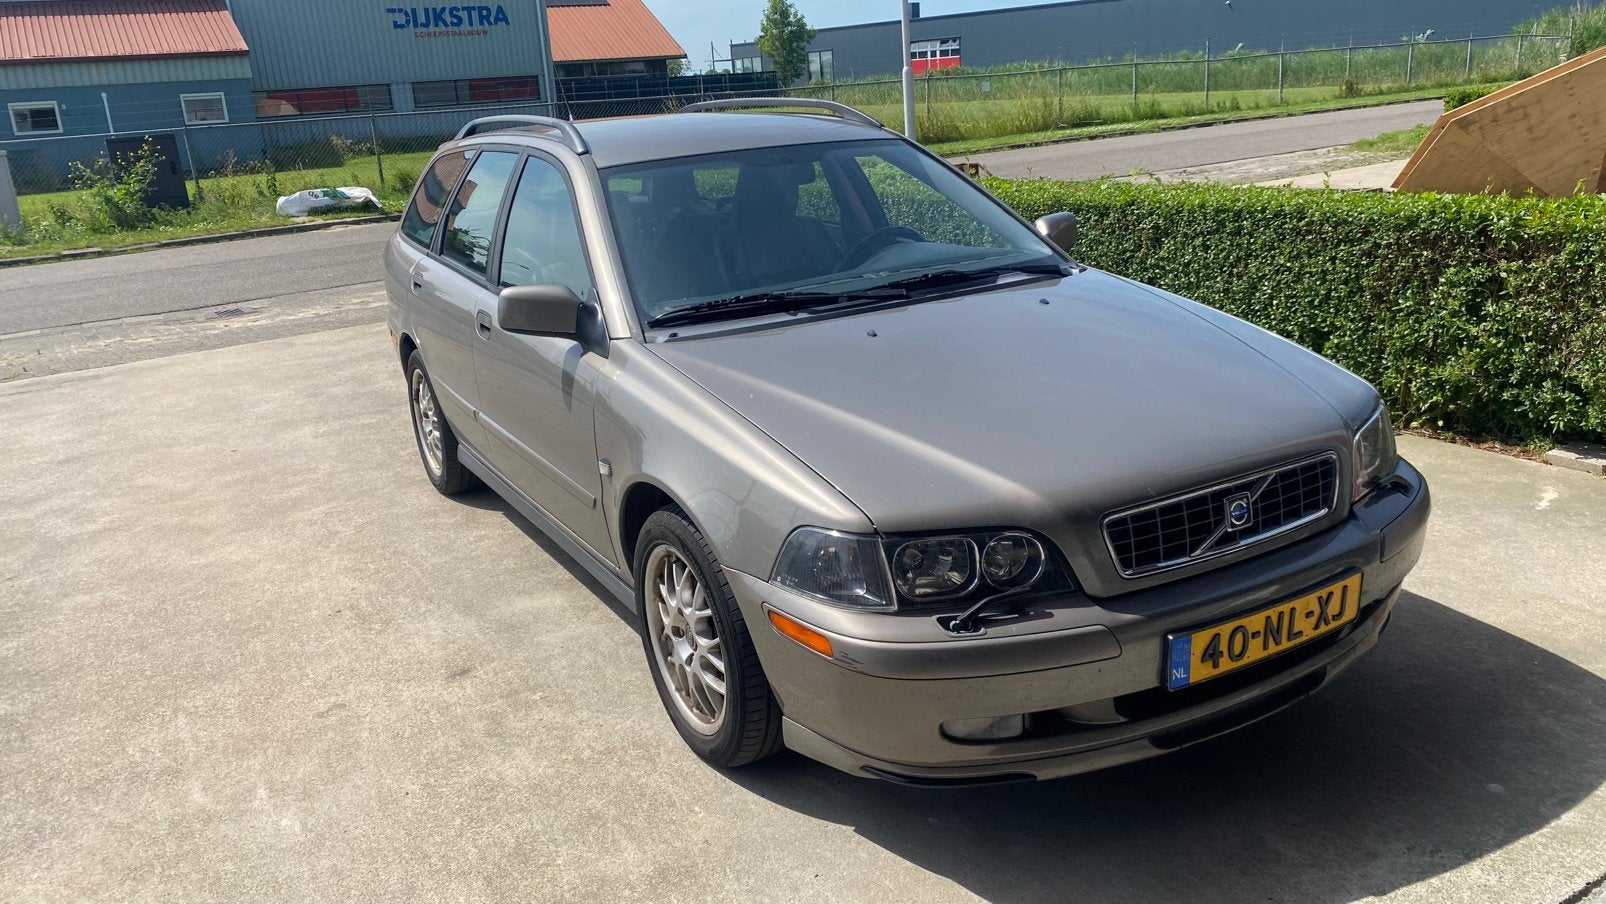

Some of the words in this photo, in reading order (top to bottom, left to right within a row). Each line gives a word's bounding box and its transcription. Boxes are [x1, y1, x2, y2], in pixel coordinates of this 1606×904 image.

[386, 5, 510, 30] DIJKSTRA
[1200, 584, 1349, 670] 40-NL-XJ
[1172, 667, 1188, 681] NL
